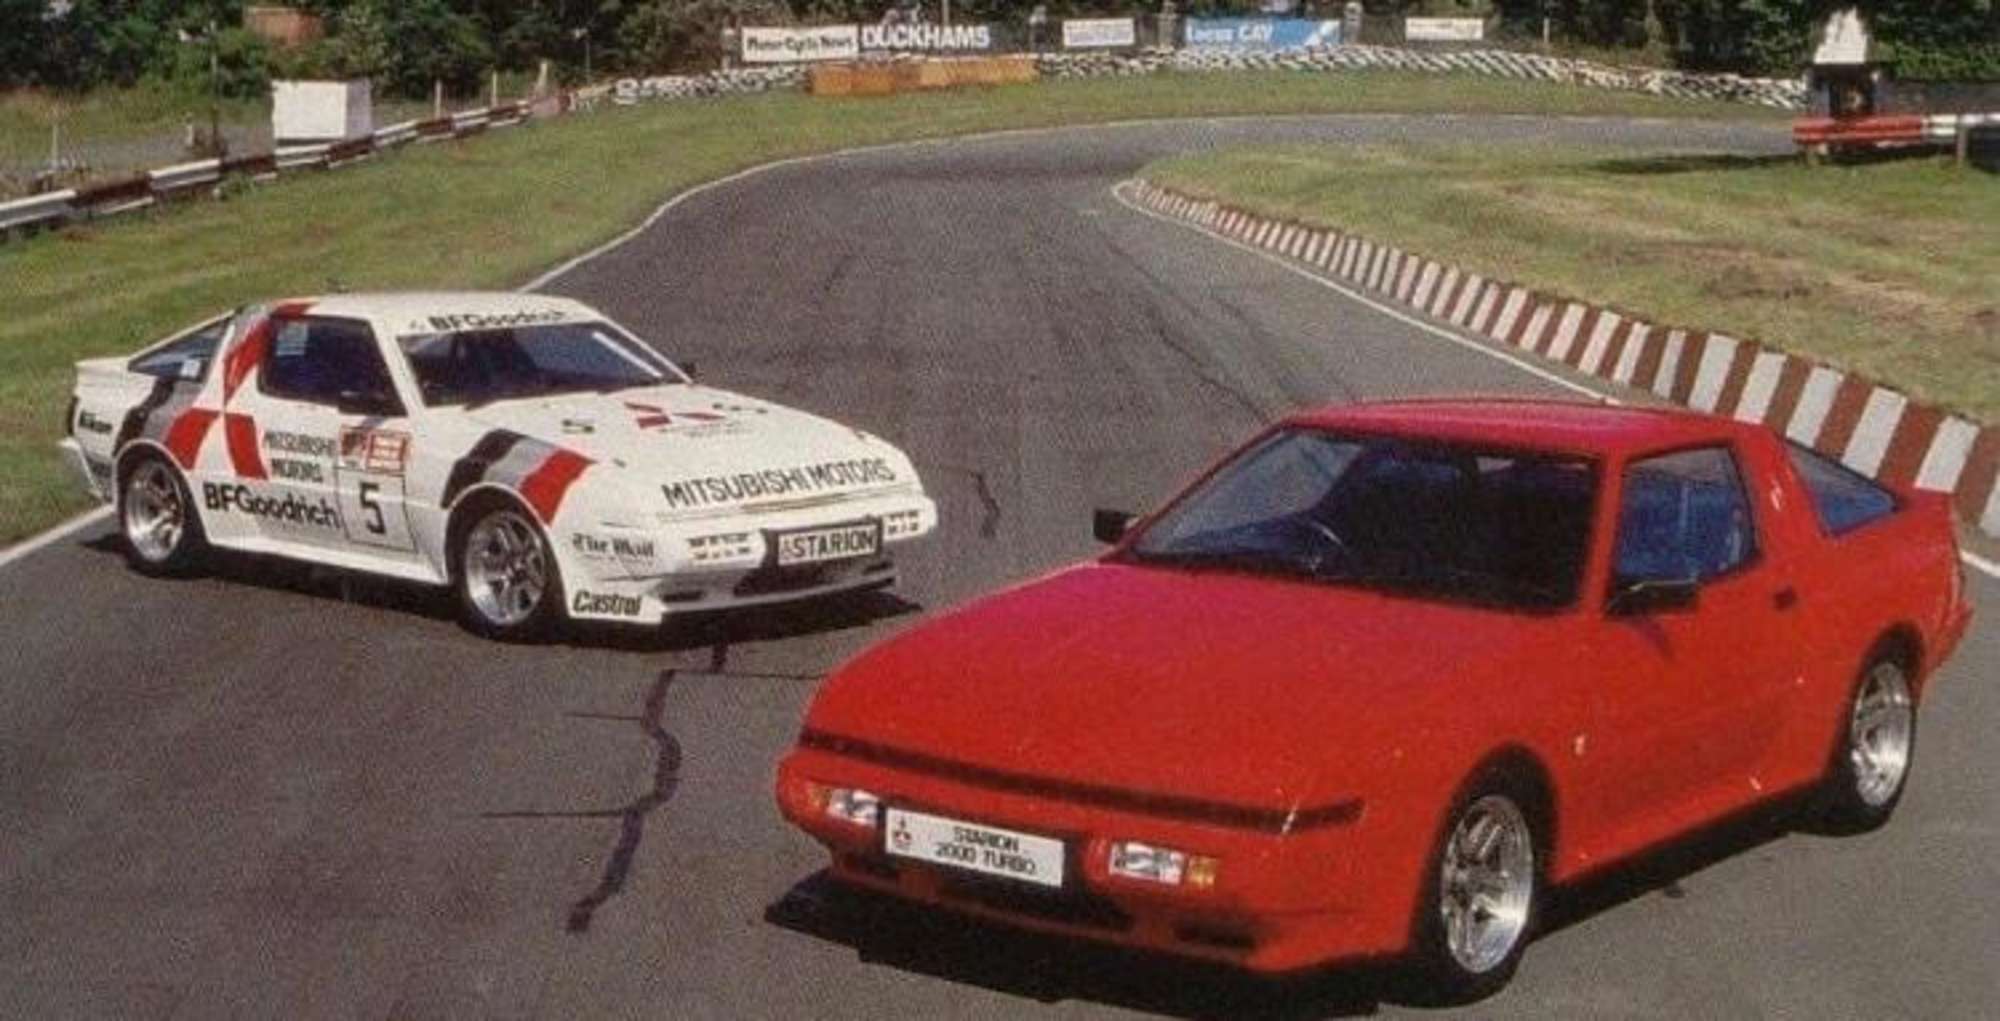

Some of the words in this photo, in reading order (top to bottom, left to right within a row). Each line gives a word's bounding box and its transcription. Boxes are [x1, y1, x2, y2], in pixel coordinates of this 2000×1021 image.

[862, 24, 989, 48] DUCKHAMS
[661, 465, 813, 508] MITSUBISHI
[814, 457, 896, 490] MOTORS
[203, 481, 341, 530] BFGoodrich
[360, 481, 386, 535] 5
[793, 530, 876, 558] STARION
[573, 590, 642, 617] Castrol
[936, 842, 976, 863] 2000
[983, 849, 1036, 875] TURBO
